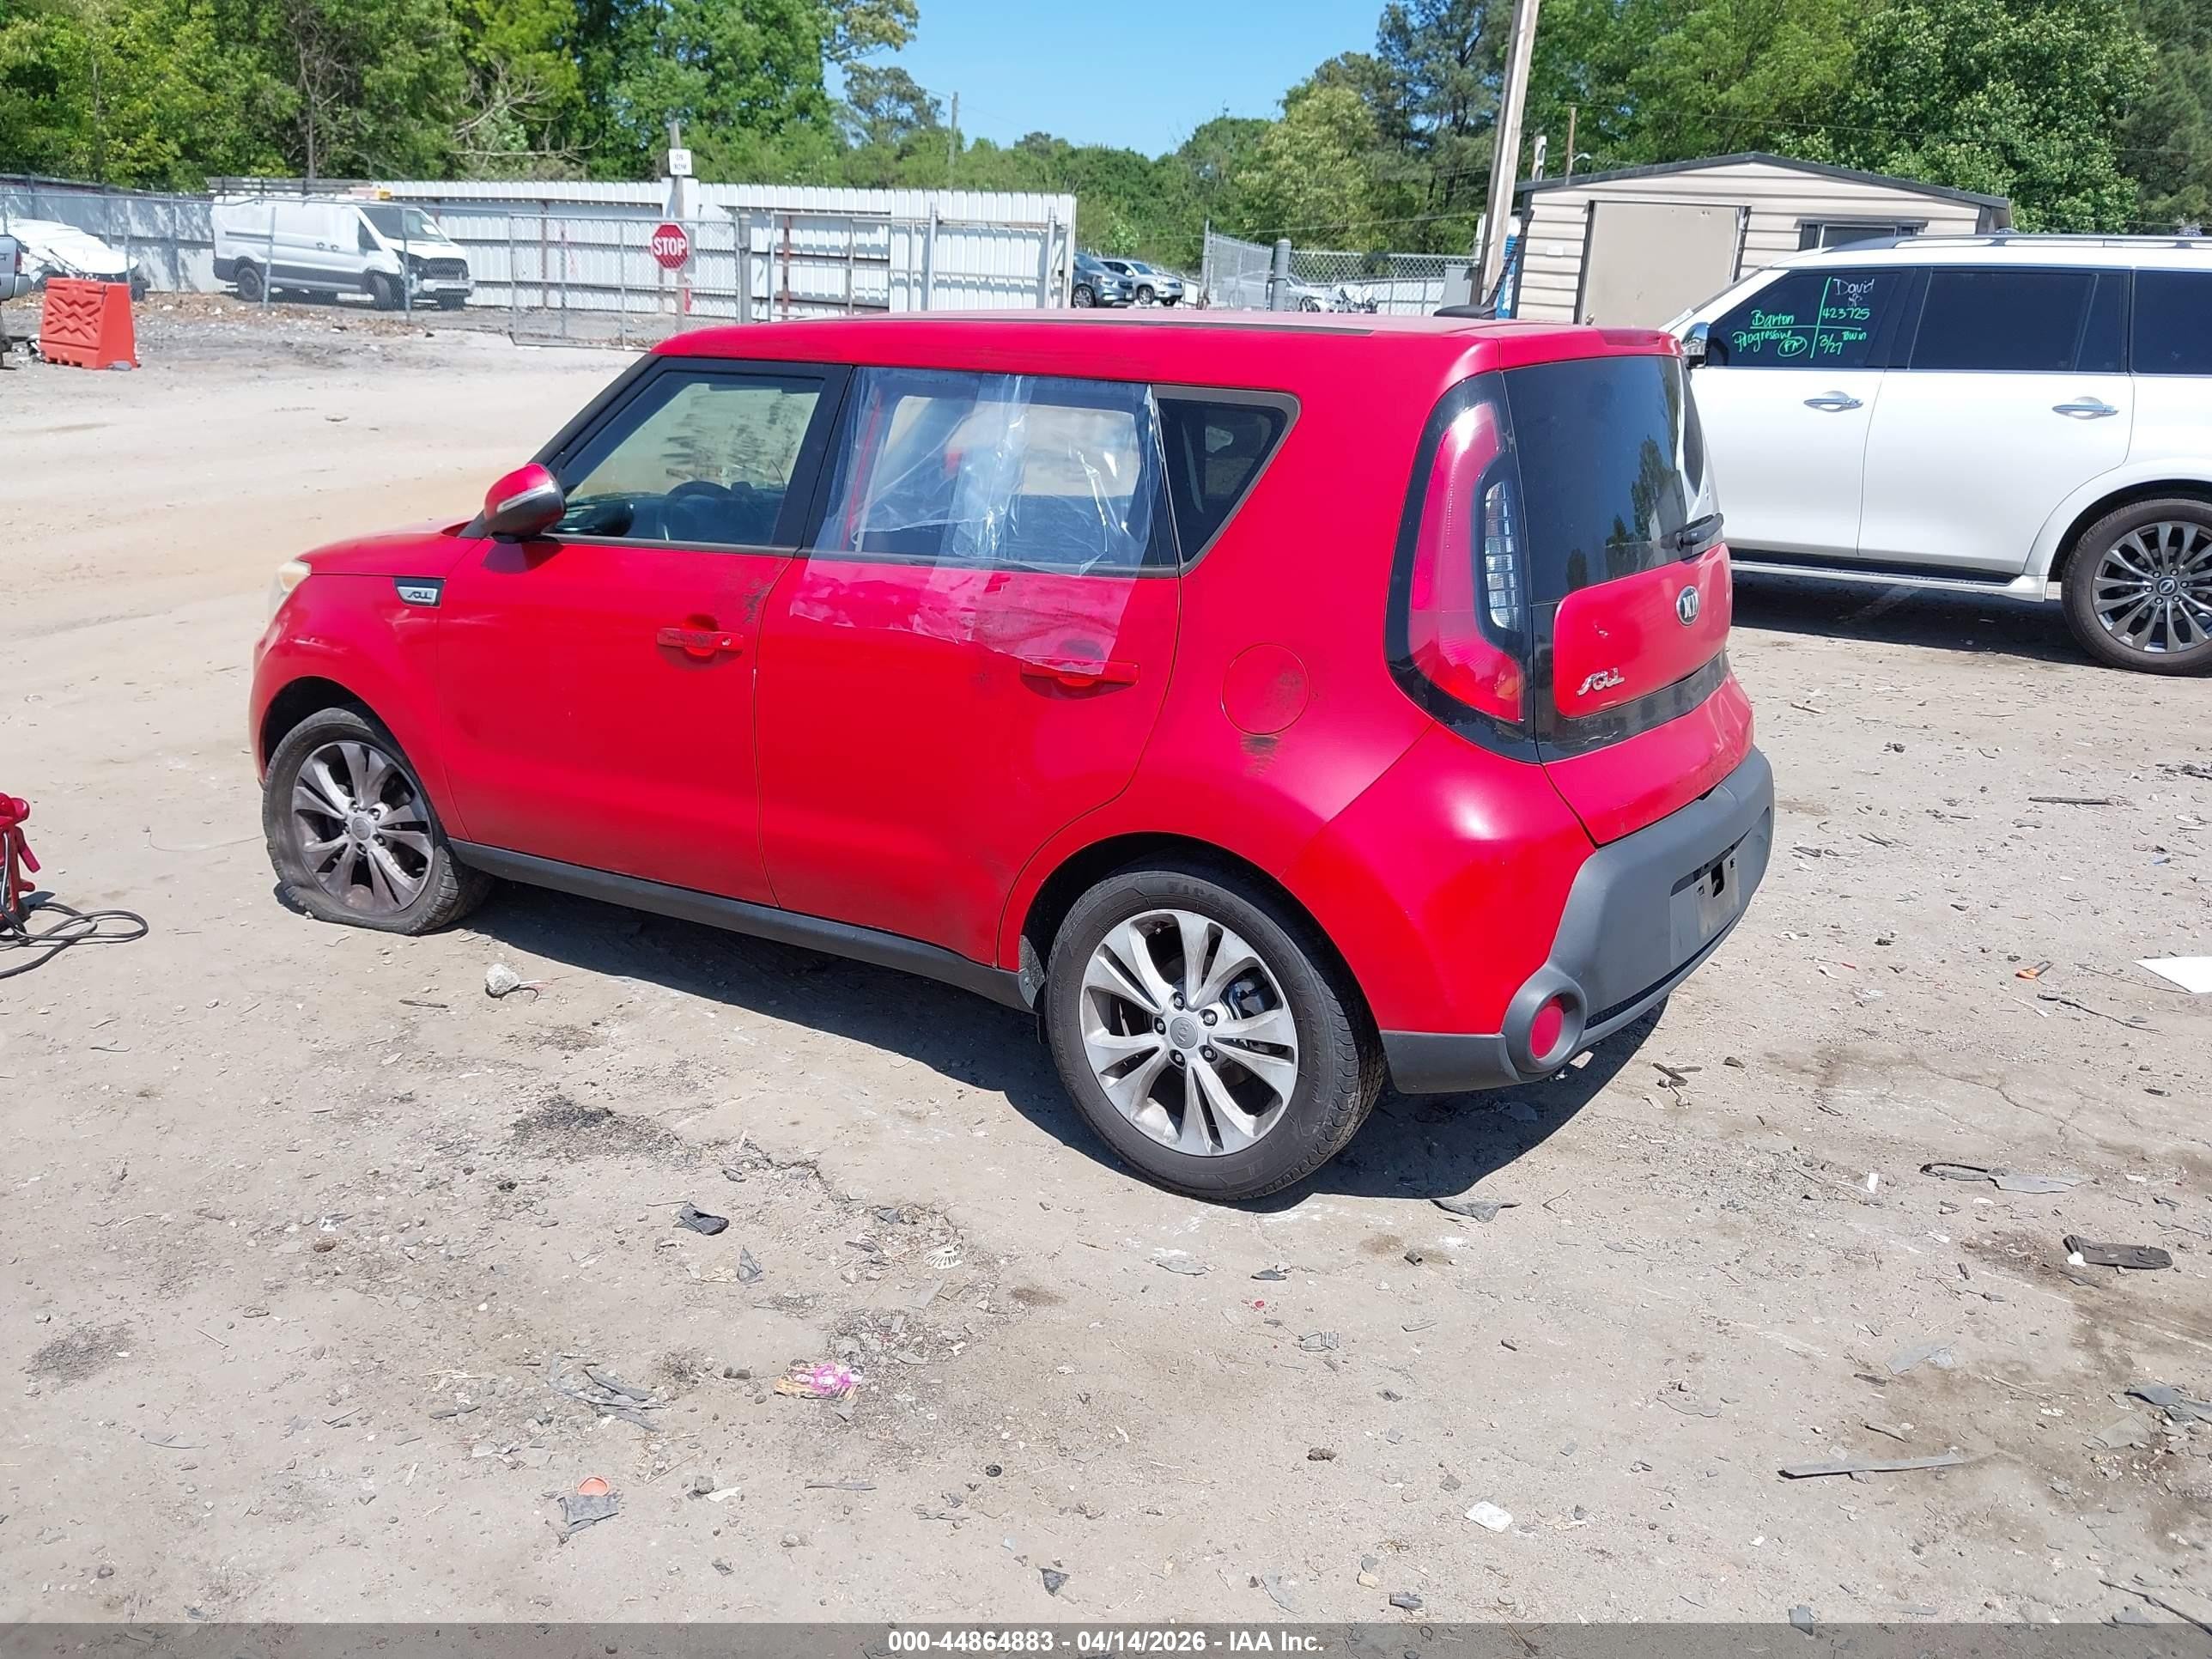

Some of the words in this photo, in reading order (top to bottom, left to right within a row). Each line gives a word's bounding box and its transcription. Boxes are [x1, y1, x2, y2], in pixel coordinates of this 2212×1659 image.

[653, 236, 686, 257] STOP
[1832, 278, 1875, 295] David
[1751, 310, 1795, 327] Barton
[1822, 307, 1870, 320] 423725
[1819, 333, 1843, 355] 3/27
